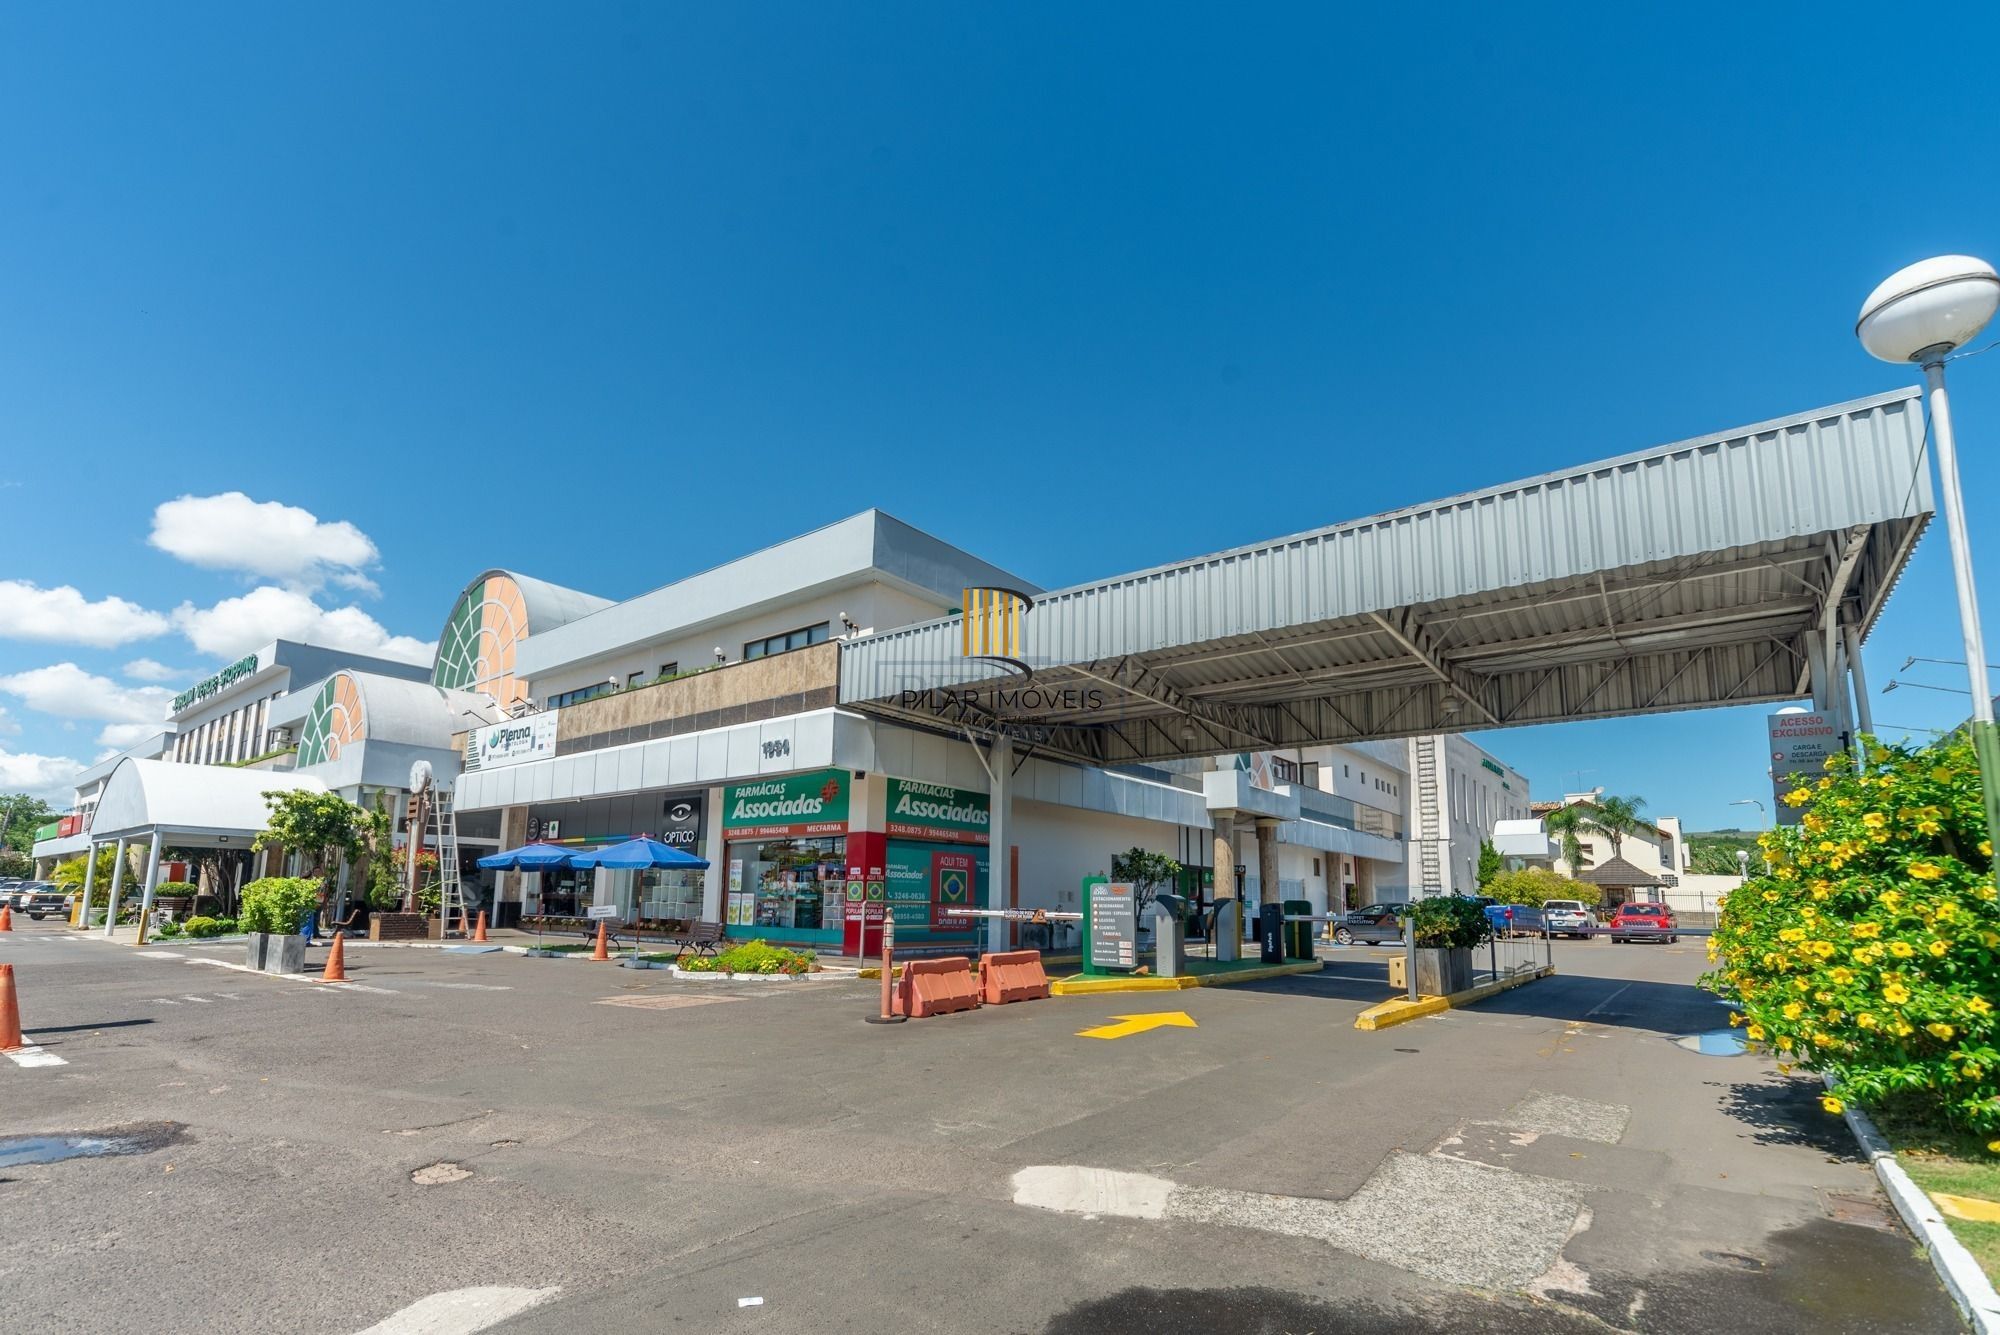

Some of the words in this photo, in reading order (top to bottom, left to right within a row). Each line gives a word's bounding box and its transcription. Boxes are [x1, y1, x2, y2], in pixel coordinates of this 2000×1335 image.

[1780, 716, 1823, 727] ACESSO
[499, 726, 531, 743] Plenna
[1772, 726, 1833, 738] EXCLUSIVO
[735, 782, 786, 798] FARMÁCIAS
[731, 792, 823, 819] Associadas
[894, 794, 989, 824] Associadas
[806, 824, 842, 833] MECFARMA
[890, 824, 922, 835] 3248.0875
[940, 856, 955, 867] AQUI
[955, 857, 969, 867] TEM
